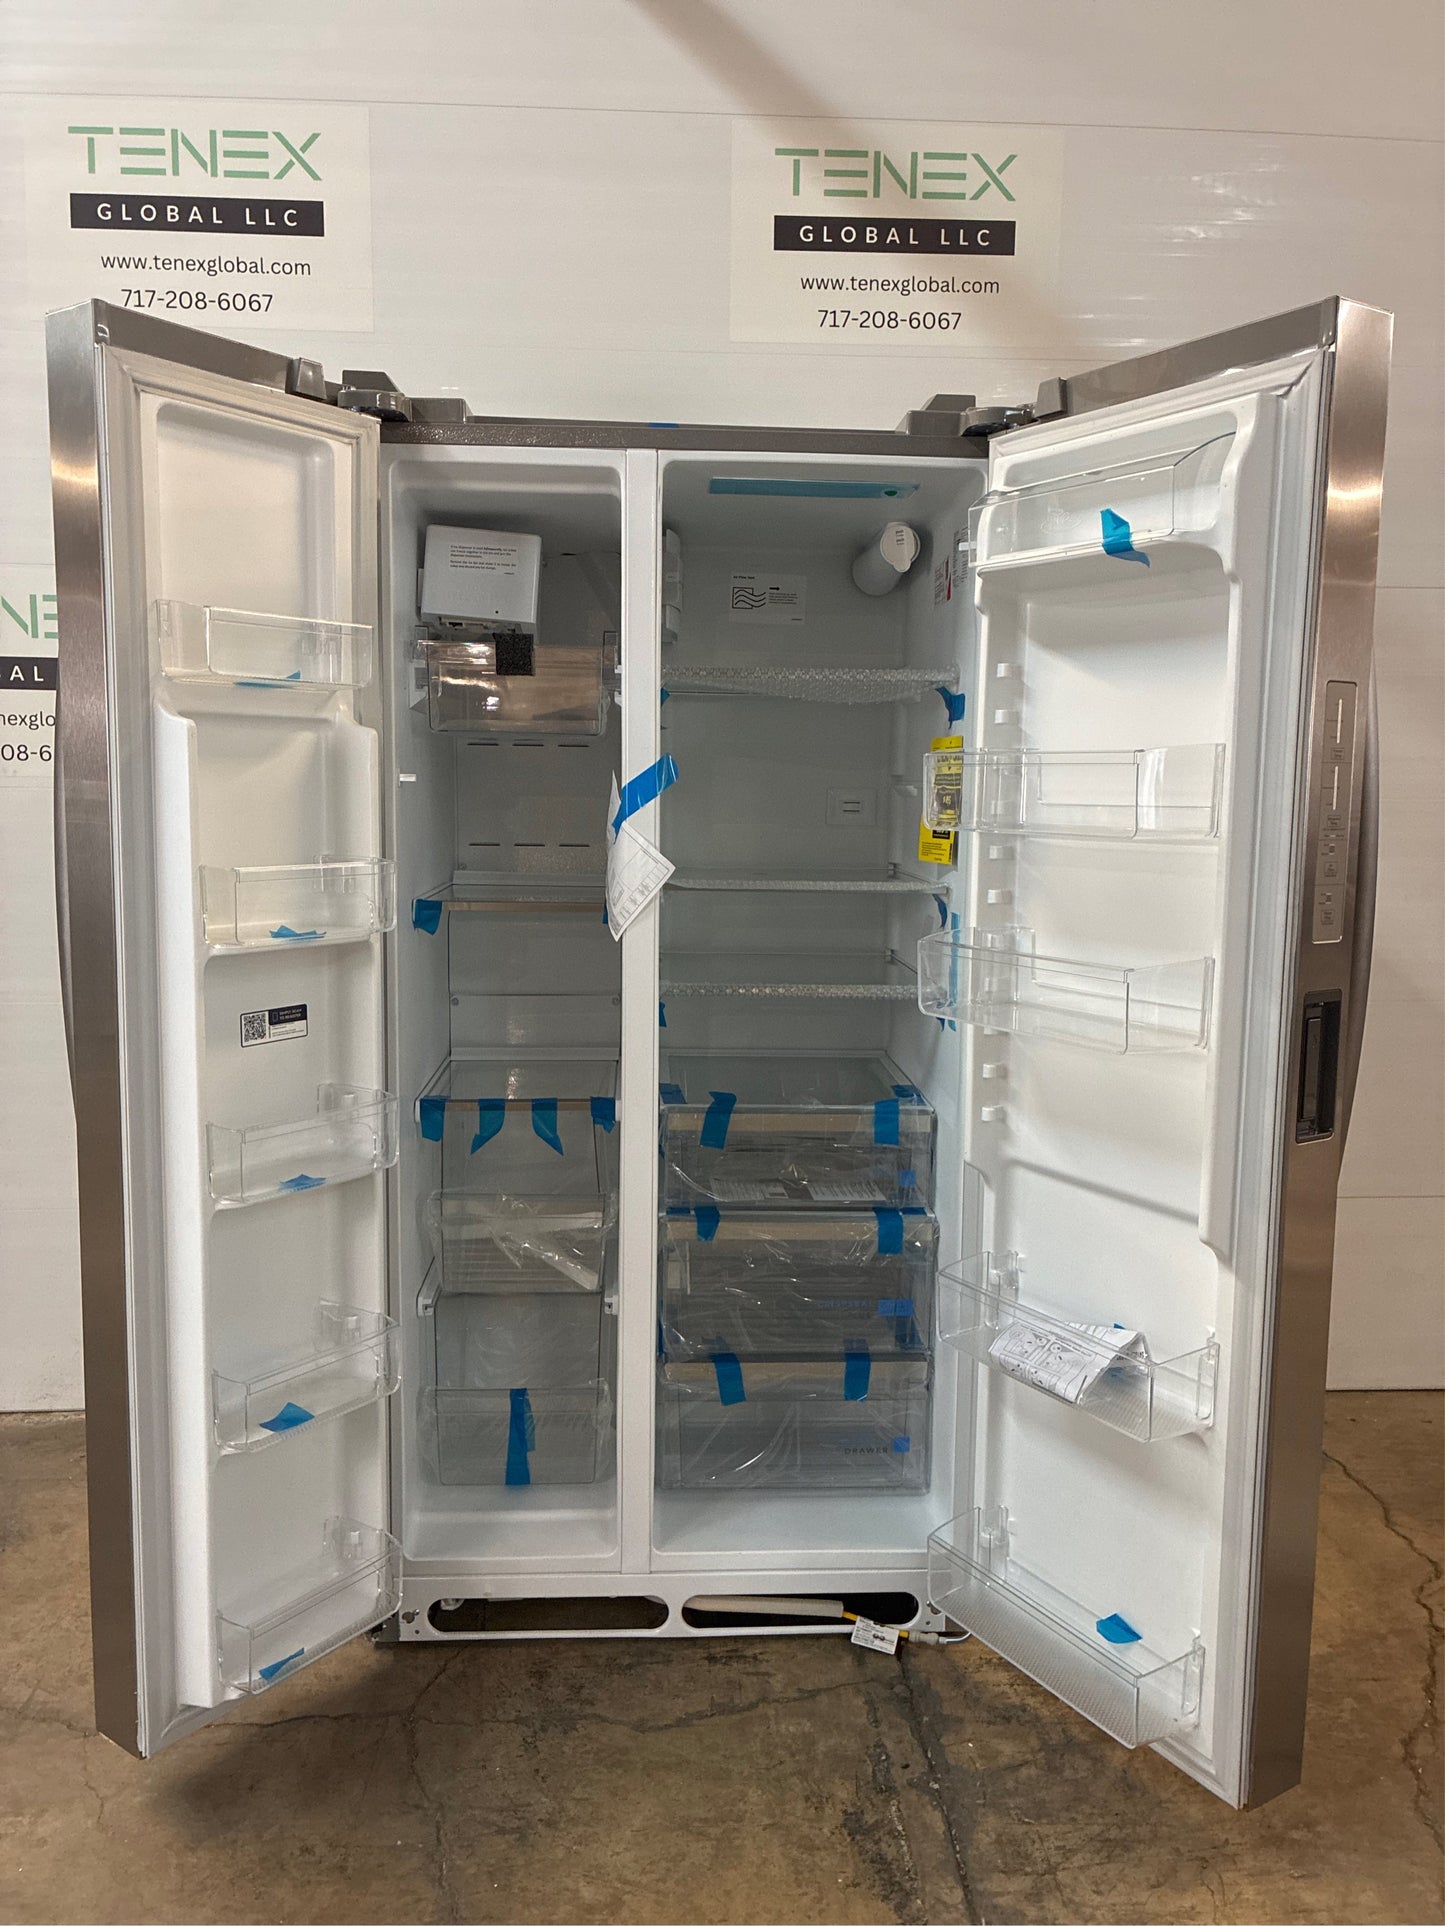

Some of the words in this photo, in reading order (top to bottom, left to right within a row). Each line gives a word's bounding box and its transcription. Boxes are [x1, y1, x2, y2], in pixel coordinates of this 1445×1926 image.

[68, 126, 322, 181] TENEX
[775, 148, 1018, 202] TENEX
[97, 203, 223, 224] GLOBAL
[245, 207, 298, 227] LLC
[799, 225, 919, 245] GLOBAL
[940, 228, 991, 247] LLC
[101, 254, 311, 277] www.tenexglobal.com
[801, 275, 1000, 296] www.tenexglobal.com
[121, 289, 273, 312] 717-208-6067
[818, 309, 962, 330] 717-208-6067
